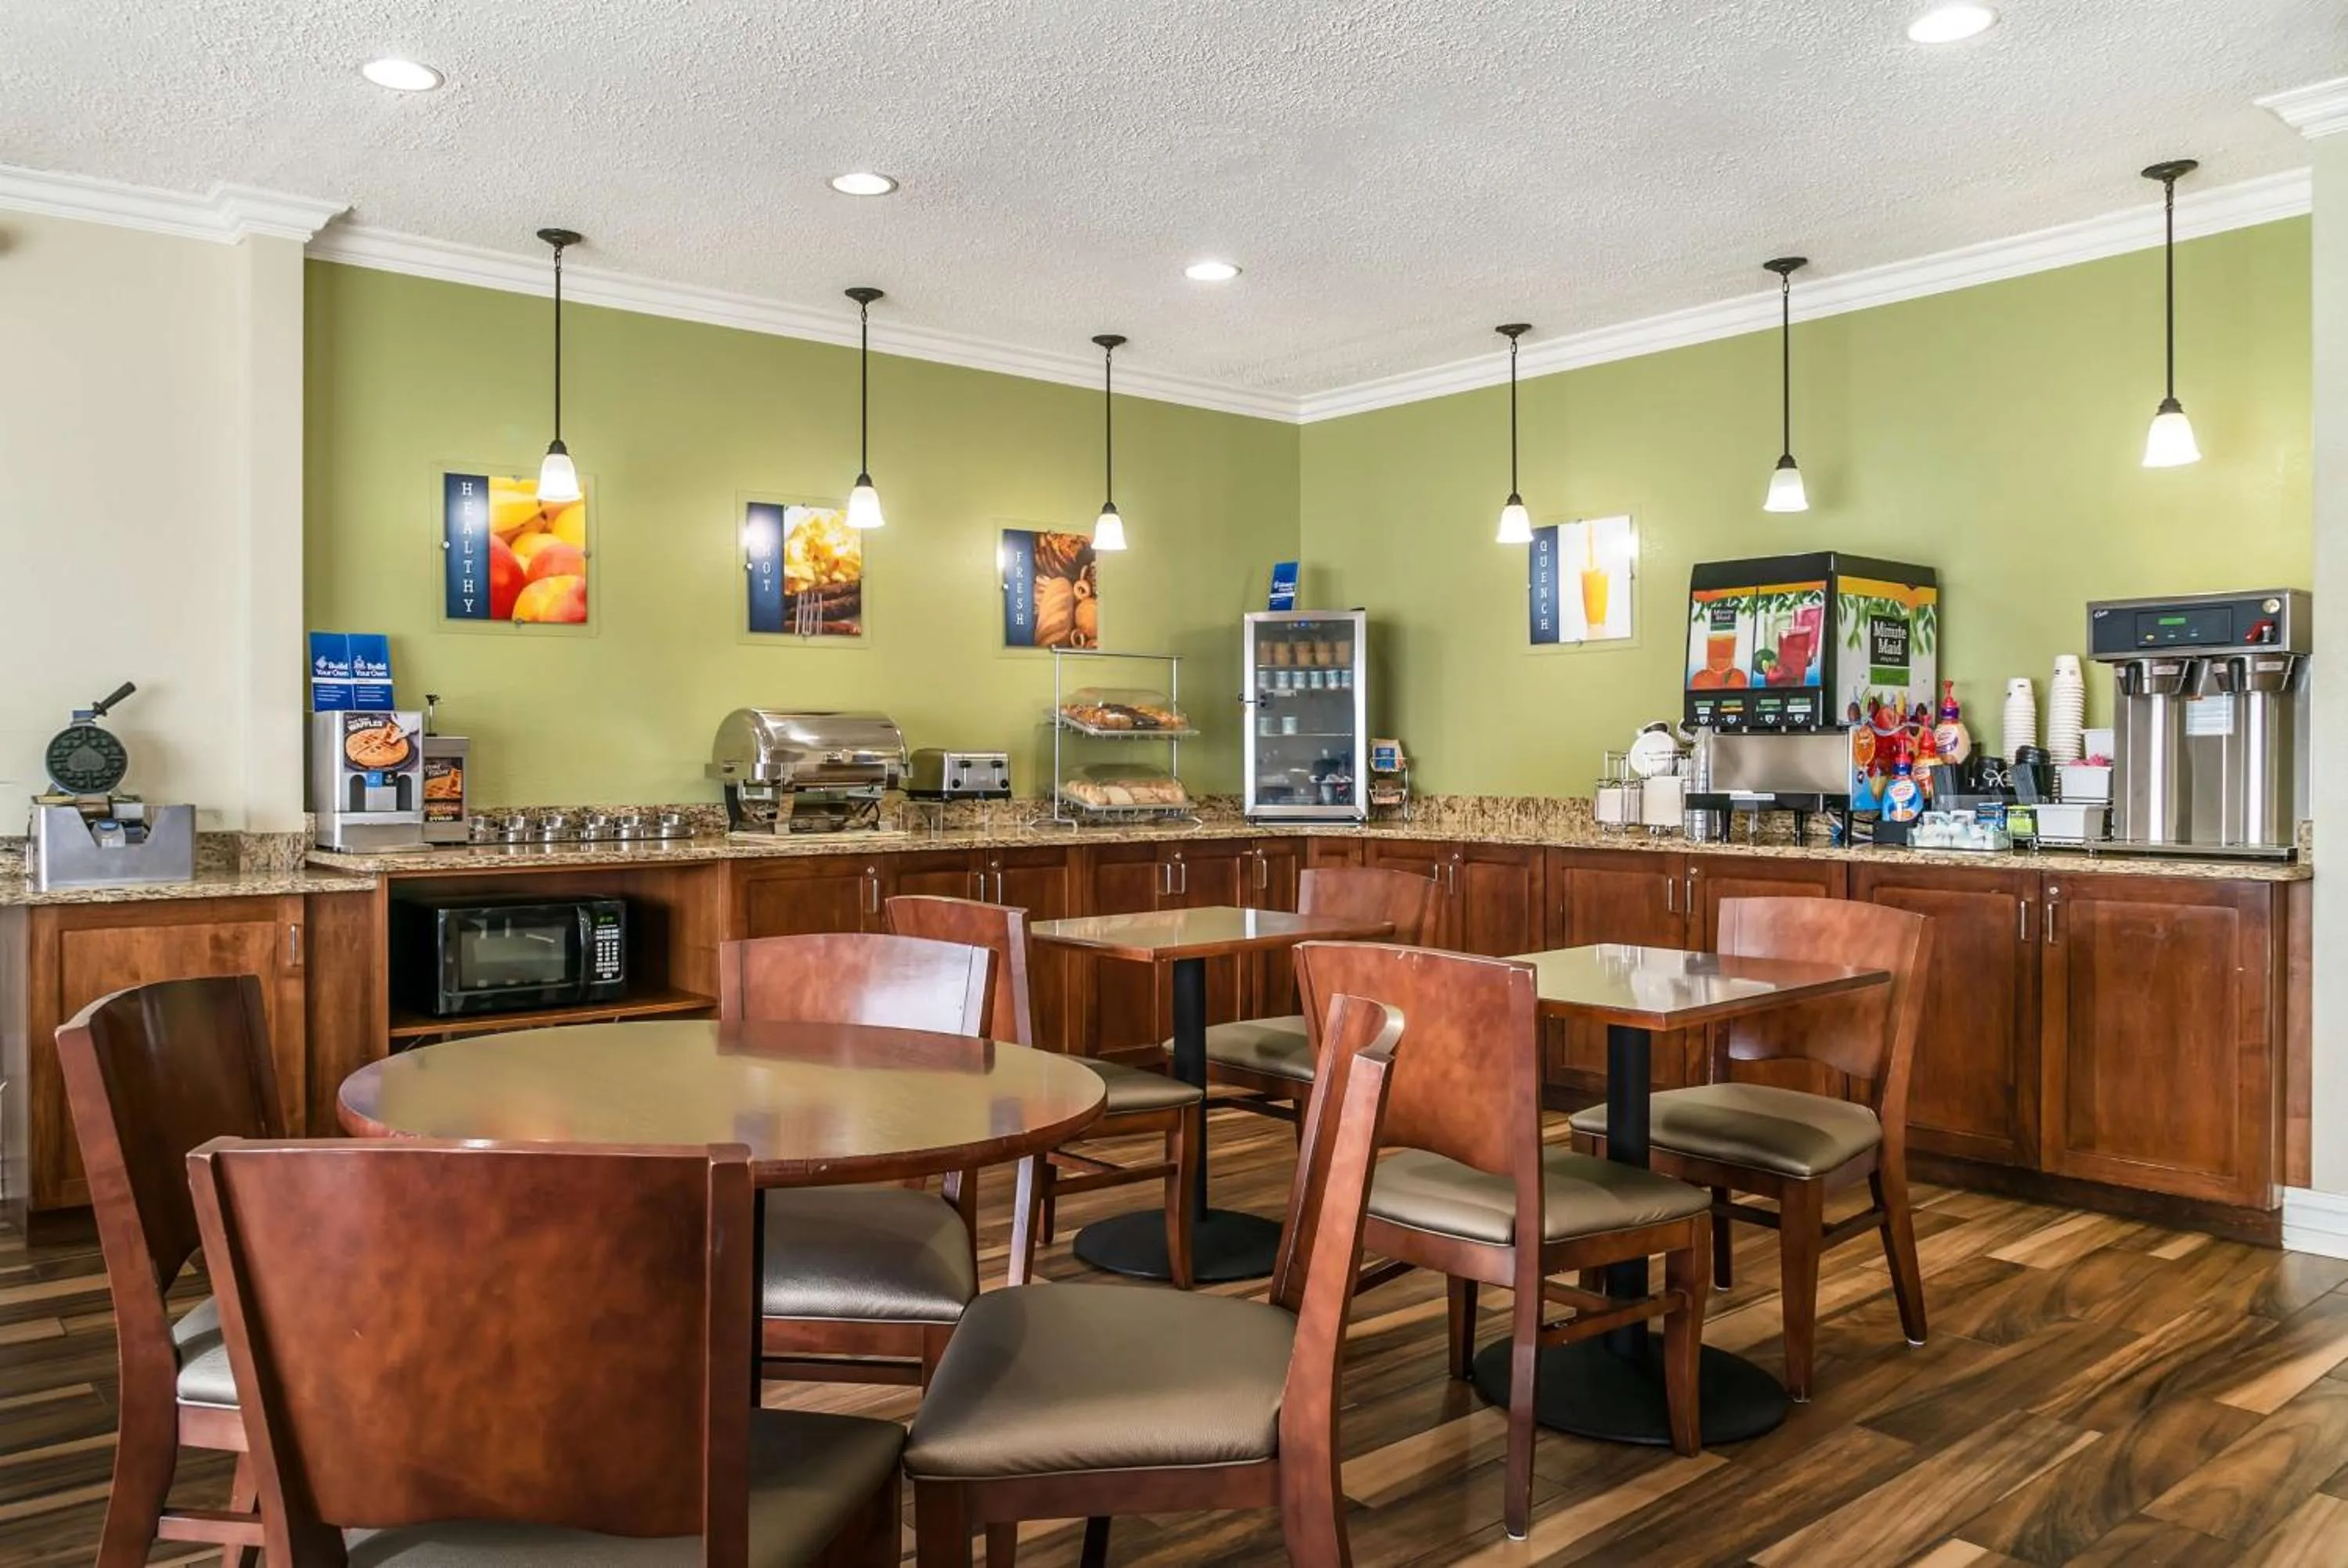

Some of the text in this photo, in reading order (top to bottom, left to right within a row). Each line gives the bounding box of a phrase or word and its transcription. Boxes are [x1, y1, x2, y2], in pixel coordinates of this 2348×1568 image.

[461, 482, 474, 613] HEALTHY
[1016, 551, 1025, 625] FRESH
[1540, 541, 1549, 630] QUENCH
[1873, 620, 1907, 639] Minute
[1878, 638, 1902, 655] Maid
